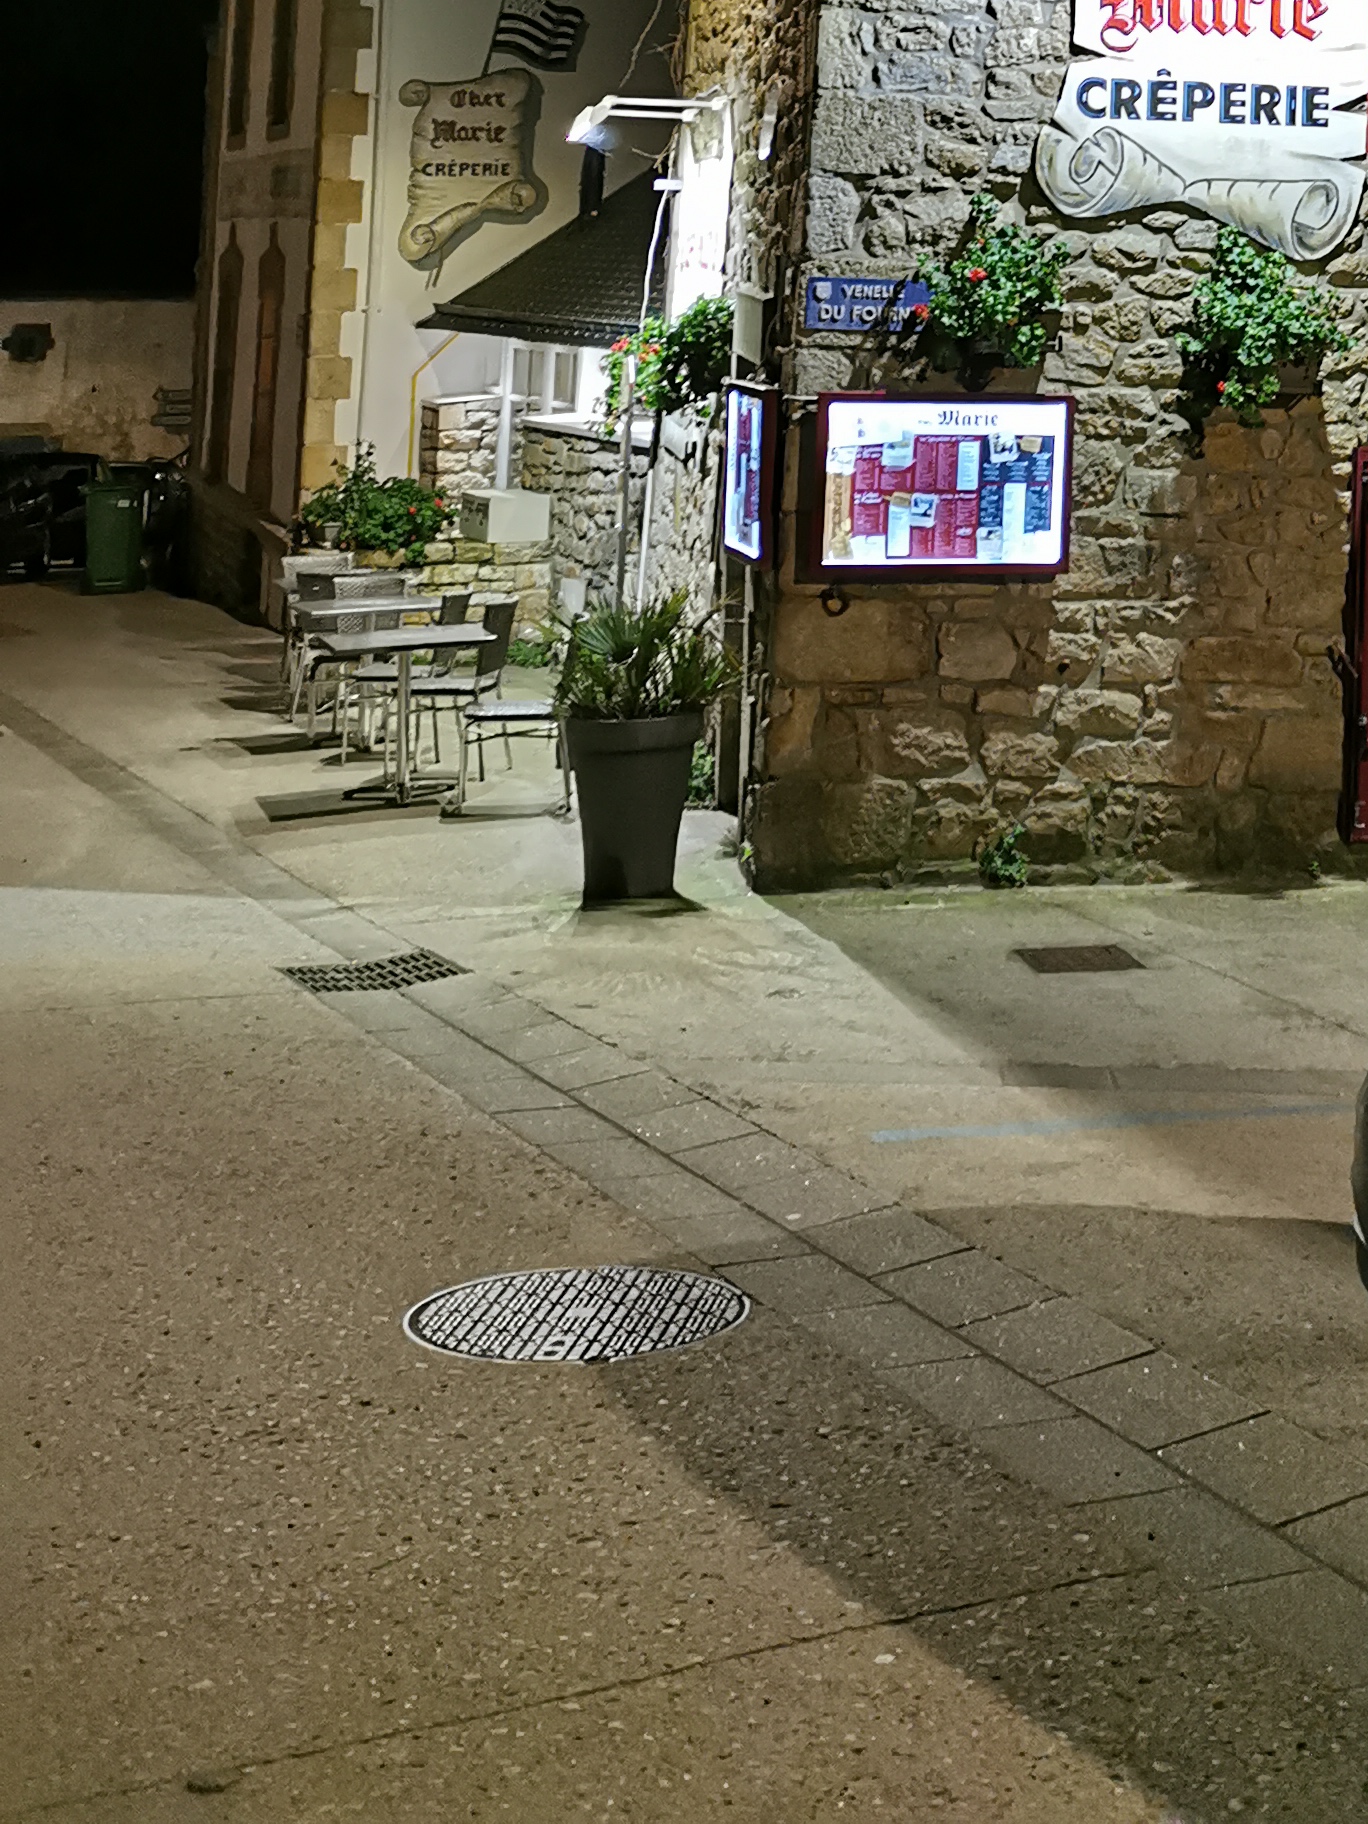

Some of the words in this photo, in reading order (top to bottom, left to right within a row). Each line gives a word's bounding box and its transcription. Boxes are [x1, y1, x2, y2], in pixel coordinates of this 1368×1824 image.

[449, 89, 506, 108] Chez
[1076, 68, 1331, 127] CRÊPERIE
[430, 118, 507, 149] Marie
[820, 304, 846, 320] DU
[937, 409, 999, 427] Marie
